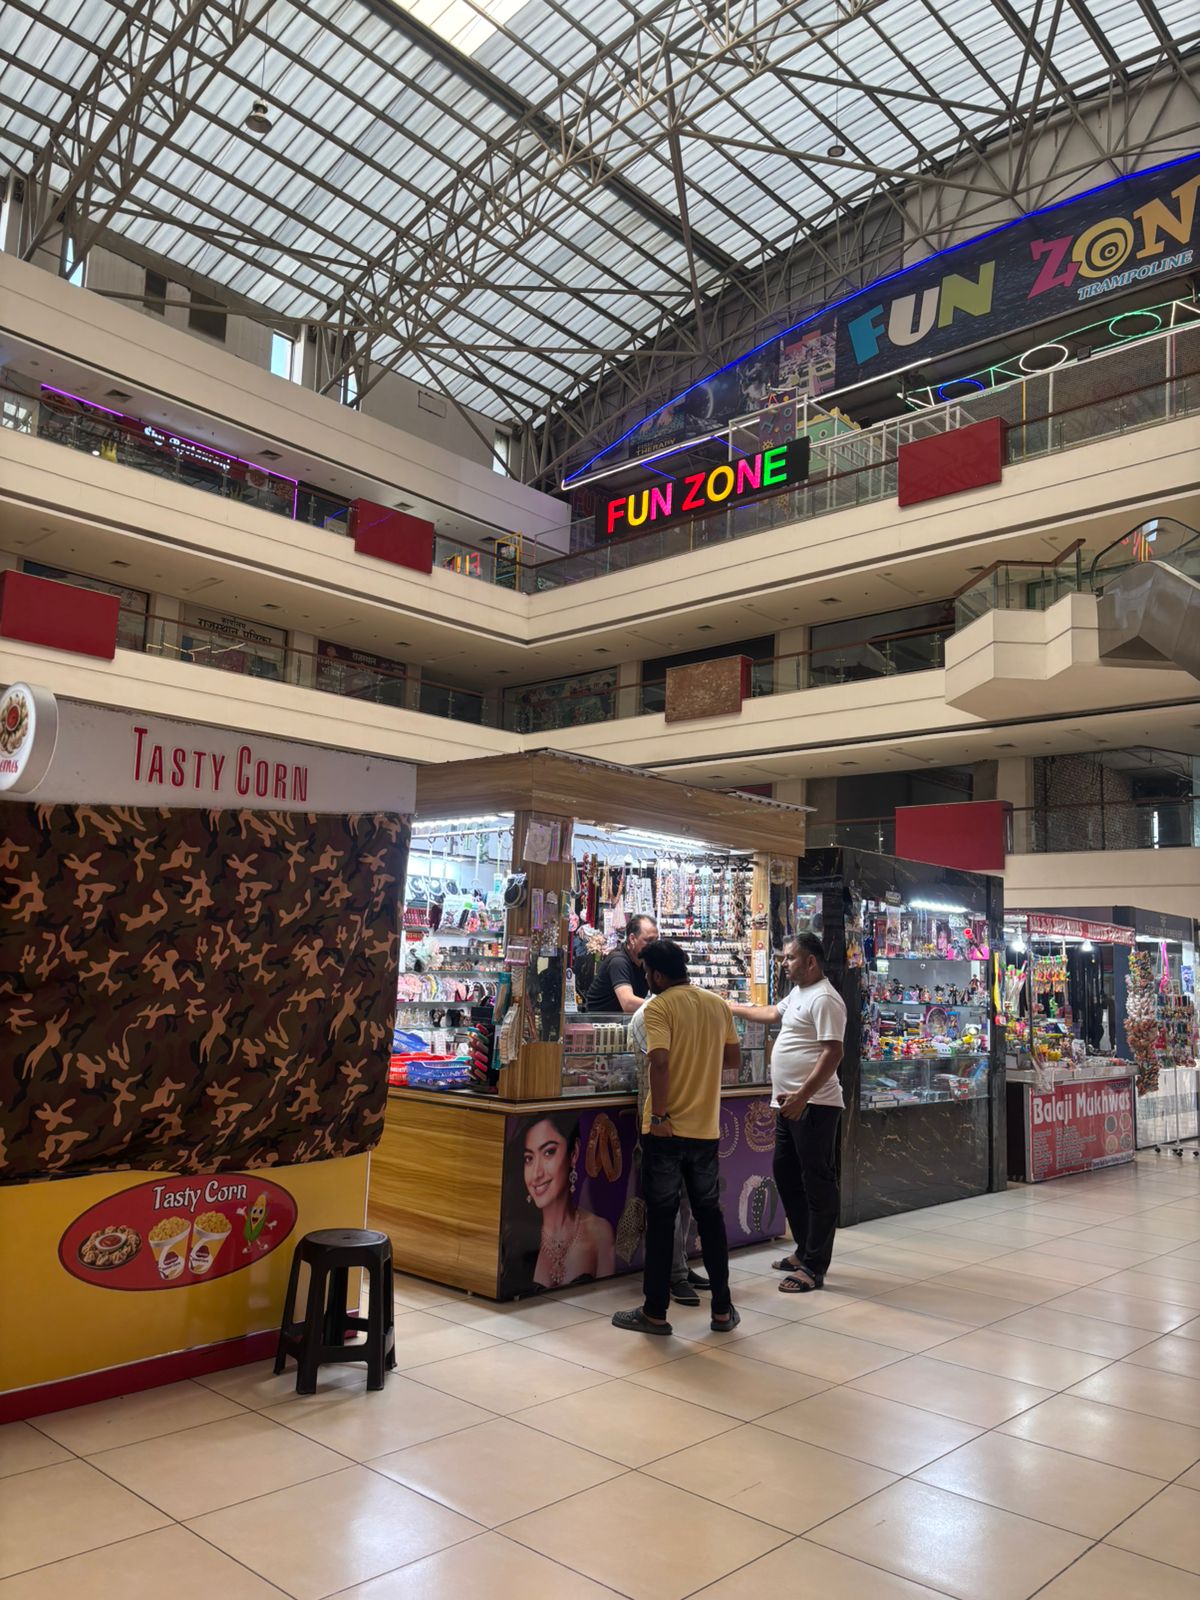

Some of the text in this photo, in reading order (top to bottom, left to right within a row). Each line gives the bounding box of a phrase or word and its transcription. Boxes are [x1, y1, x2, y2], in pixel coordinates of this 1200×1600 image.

[848, 174, 1200, 364] FUN ZON
[1077, 249, 1193, 301] TRAMPOLINE
[636, 438, 677, 455] THERAPY
[607, 482, 673, 534] FUN
[681, 446, 788, 511] ZONE
[198, 617, 273, 645] राजस्थान पत्रिका
[1033, 1090, 1131, 1125] Balaji Mukhwas
[152, 1180, 247, 1213] Tasty Corn
